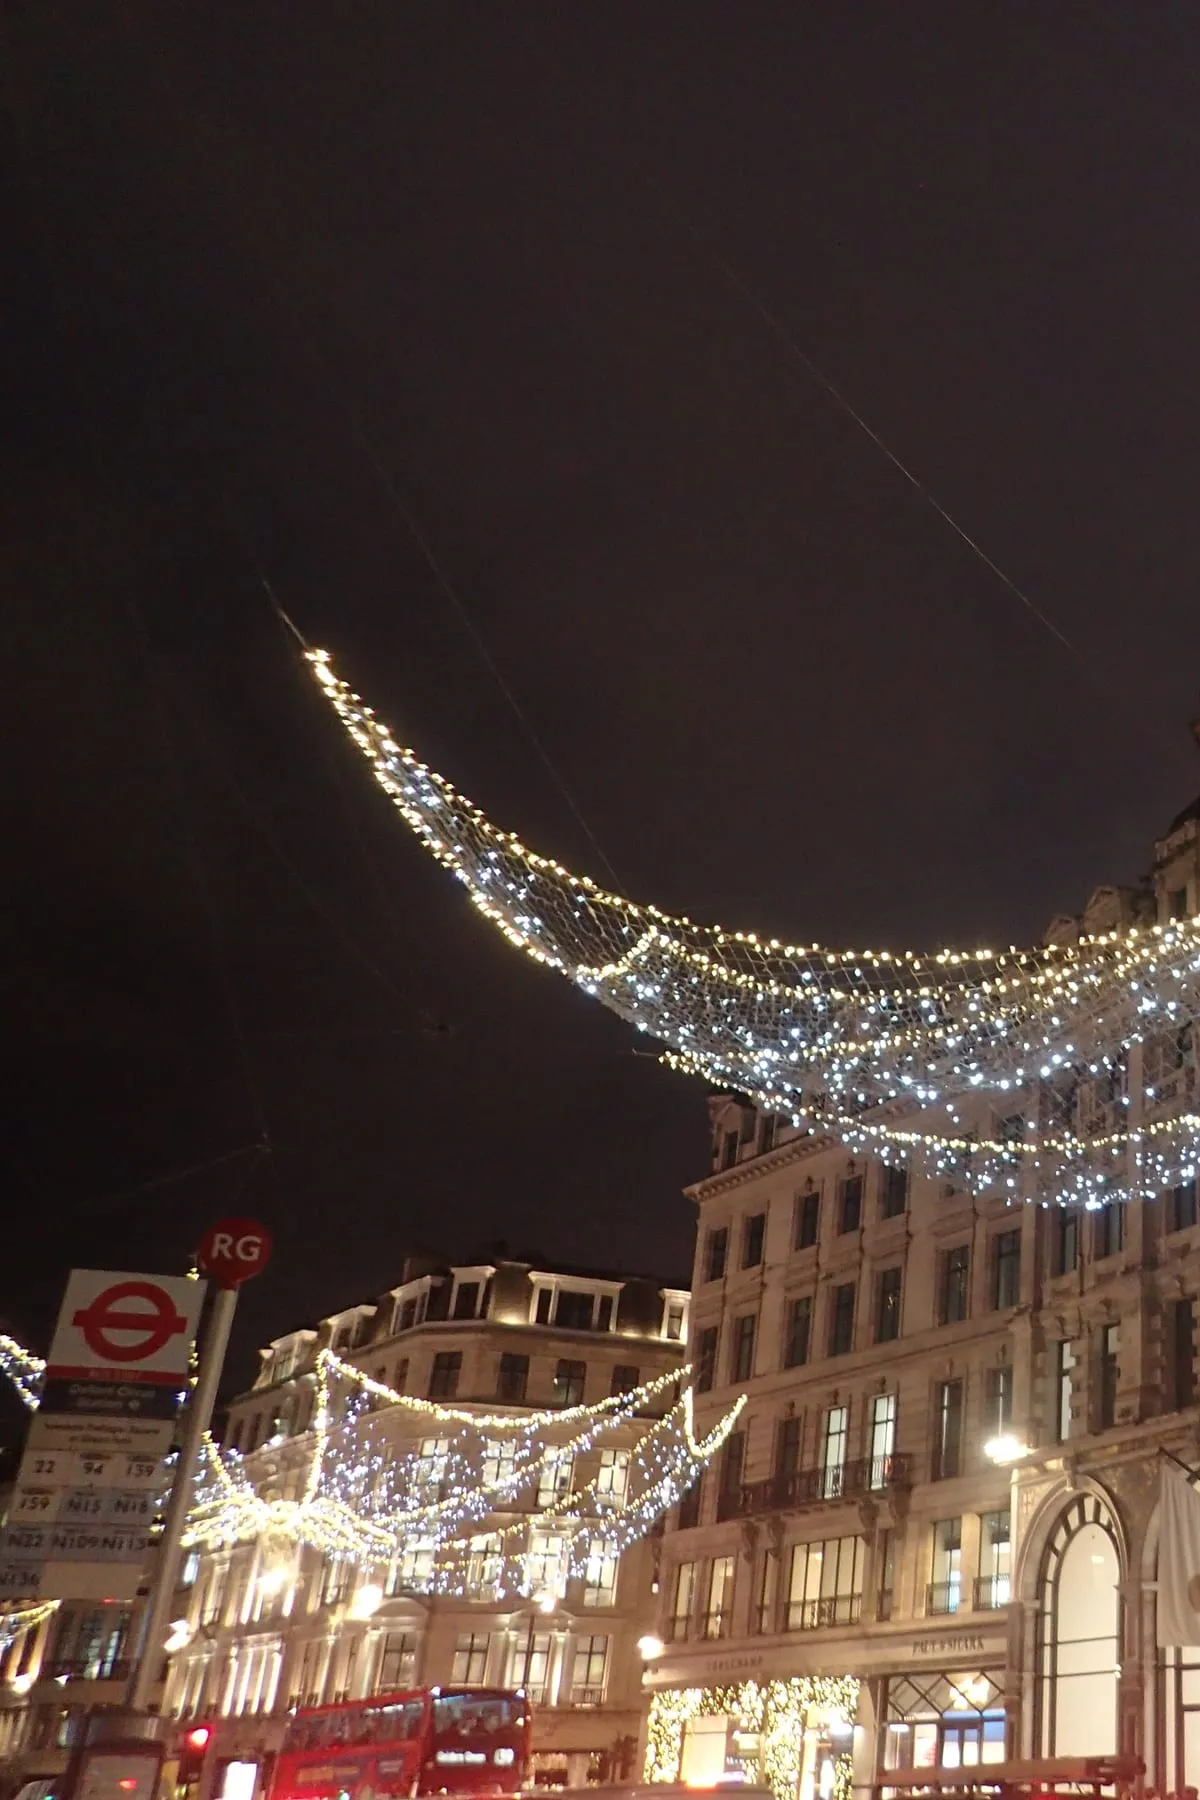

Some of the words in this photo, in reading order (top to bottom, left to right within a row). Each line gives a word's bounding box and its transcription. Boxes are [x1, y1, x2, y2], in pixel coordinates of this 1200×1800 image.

[211, 1232, 262, 1262] RG
[34, 1460, 56, 1474] 22
[83, 1462, 104, 1475] 94
[20, 1496, 50, 1510] 159
[68, 1498, 101, 1514] N15
[8, 1533, 43, 1548] N22
[51, 1534, 99, 1549] N109
